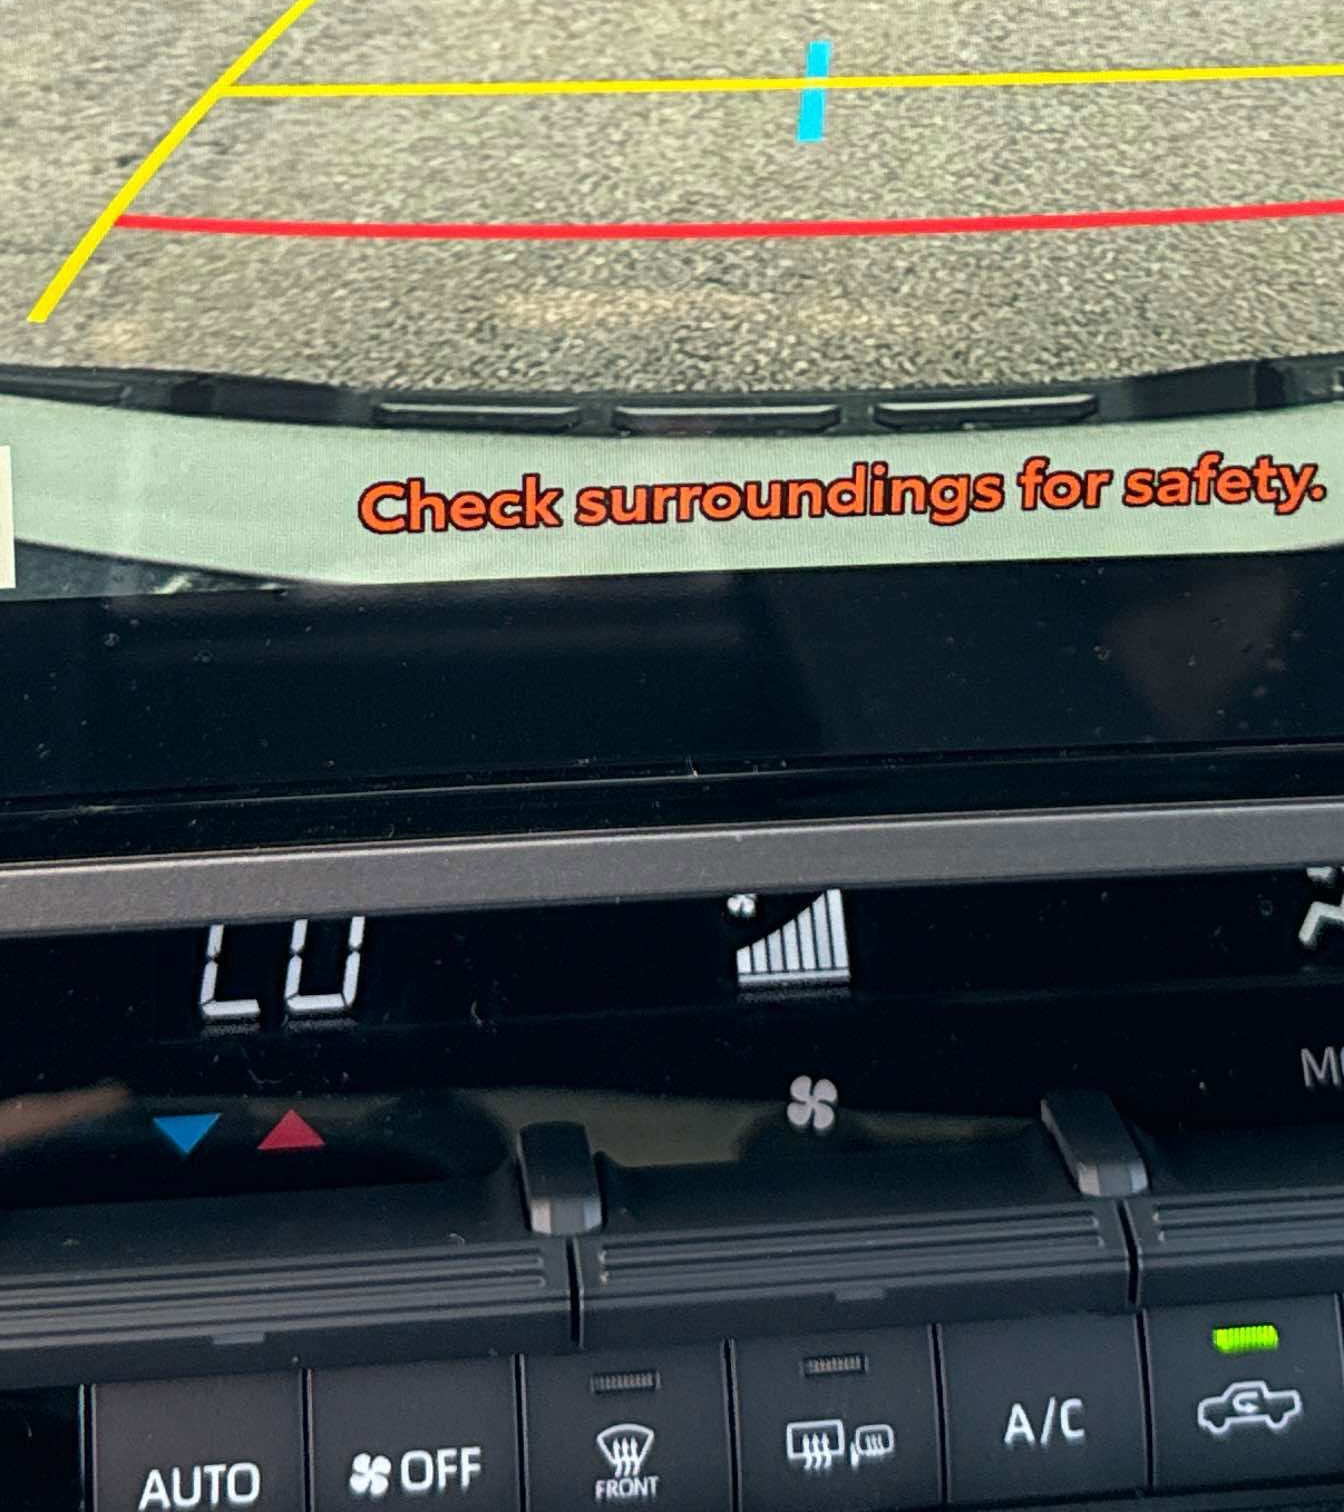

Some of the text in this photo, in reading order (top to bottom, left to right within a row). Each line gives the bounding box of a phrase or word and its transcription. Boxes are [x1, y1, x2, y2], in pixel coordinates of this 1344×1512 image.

[359, 451, 1329, 534] Check surroundings for safety.
[1004, 1396, 1085, 1447] A/C
[138, 1462, 261, 1511] AUTO
[400, 1446, 482, 1491] OFF
[595, 1477, 658, 1500] FRONT
